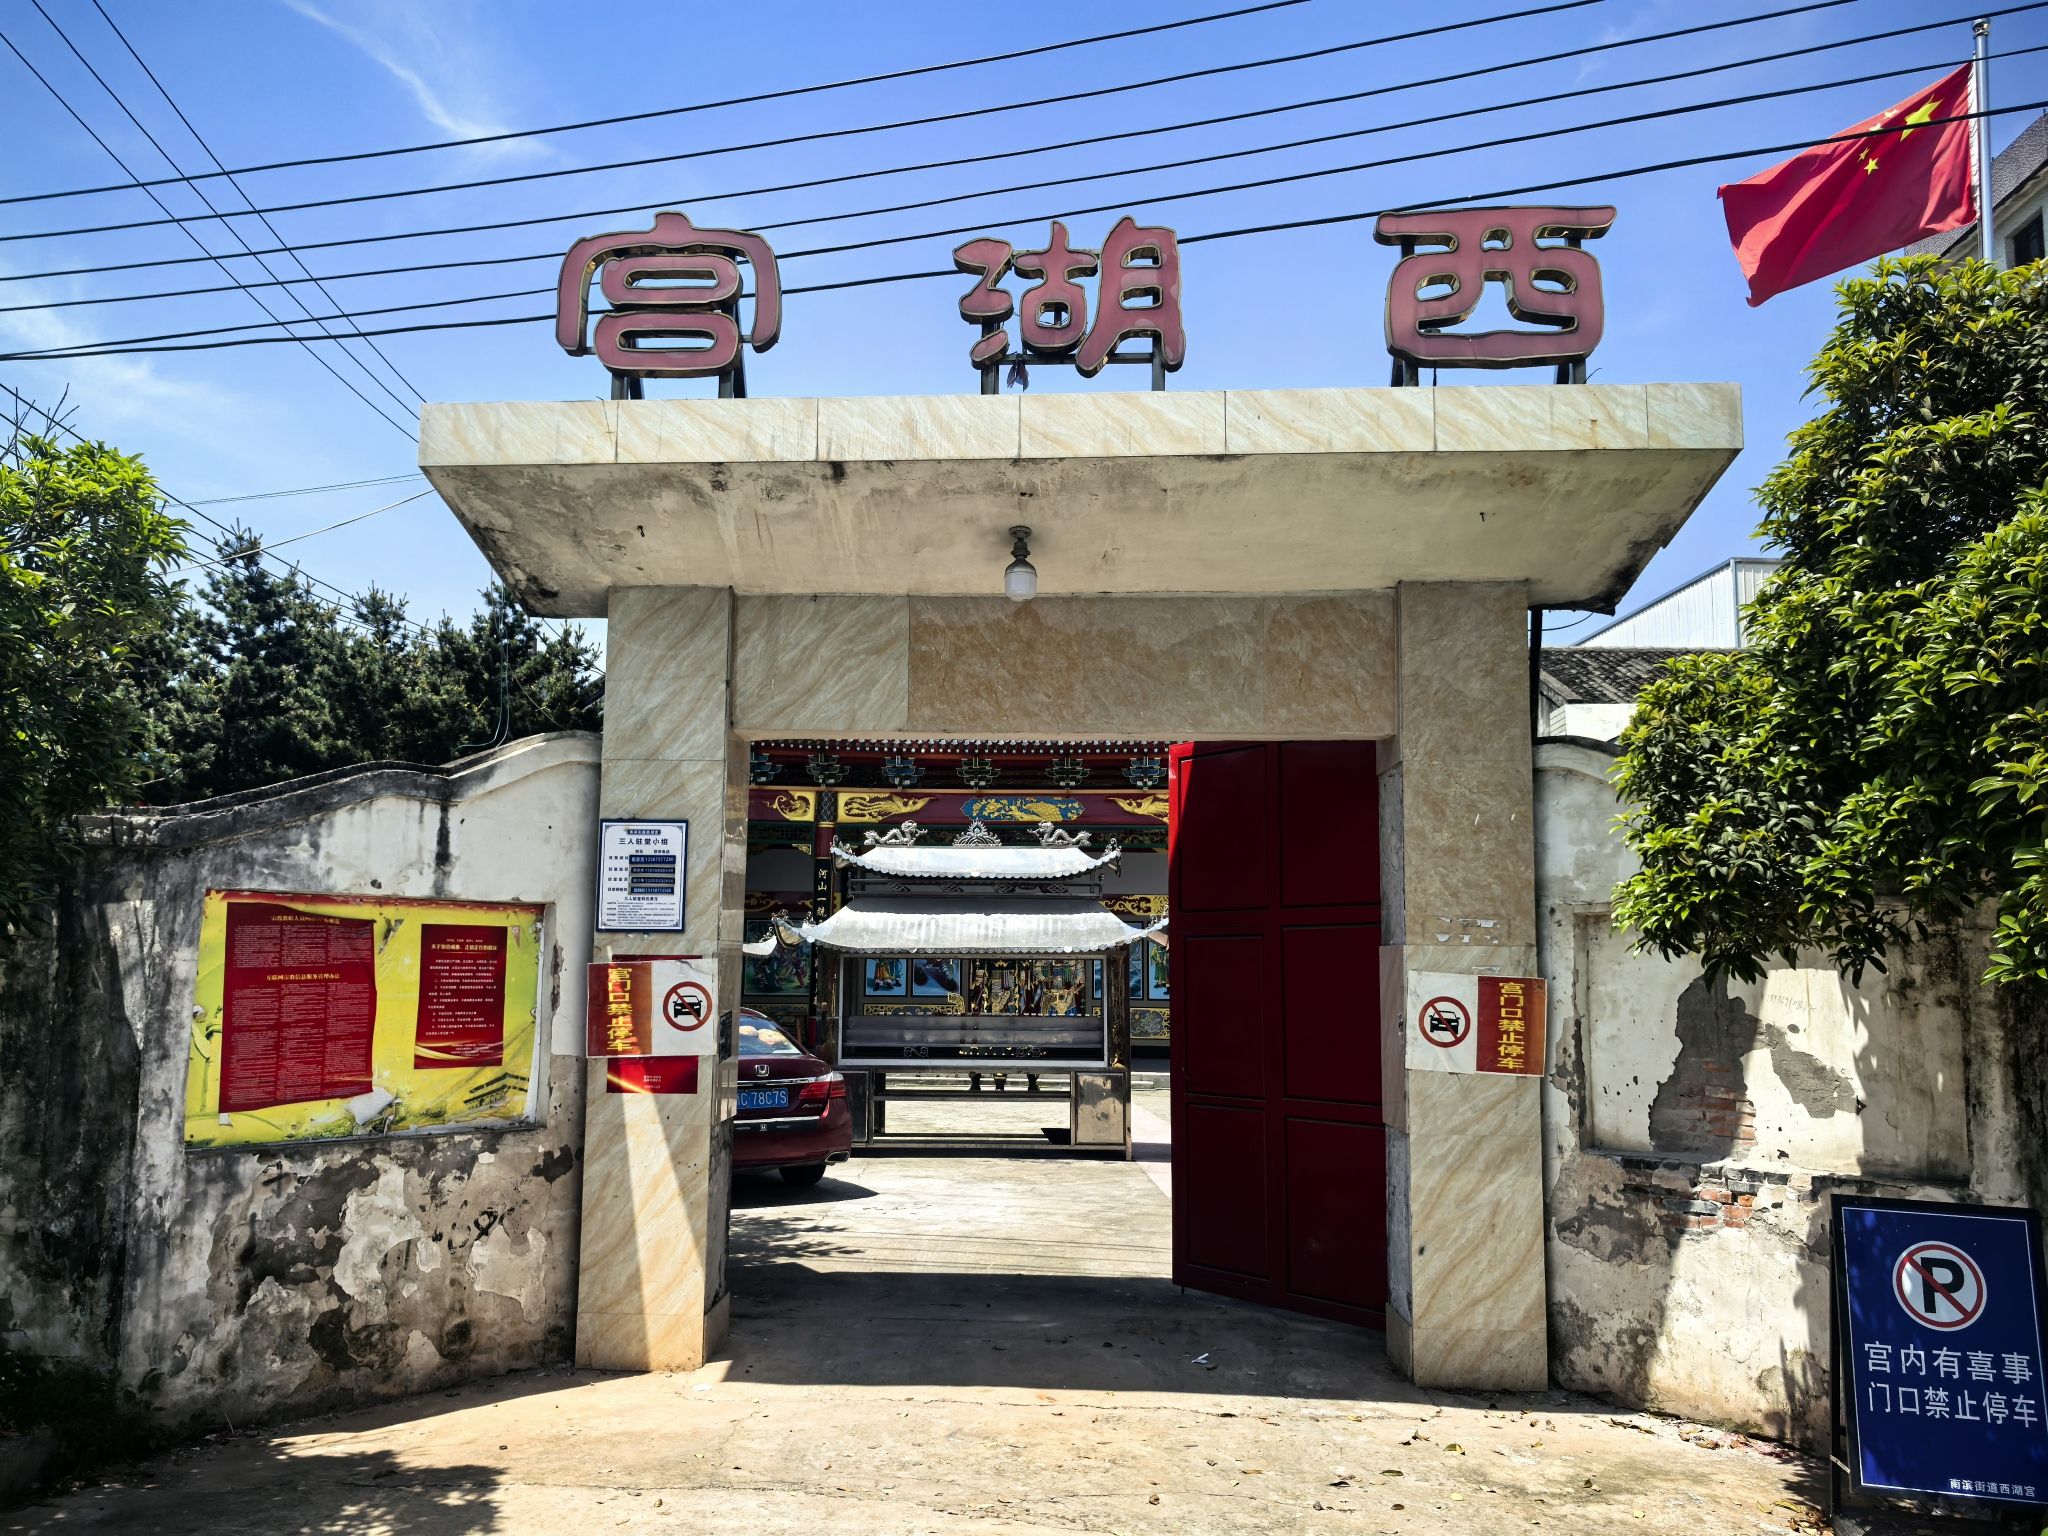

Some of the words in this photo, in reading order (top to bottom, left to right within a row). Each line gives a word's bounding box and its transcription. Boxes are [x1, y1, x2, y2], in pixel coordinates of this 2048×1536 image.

[607, 967, 633, 1052] 宫门口禁止停车
[1497, 982, 1525, 1070] 宫门口禁止停车
[1864, 1340, 2033, 1385] 宫内有喜事
[1867, 1381, 2039, 1428] 门口禁止停车
[1949, 1478, 2036, 1498] 南滨街道西湖宫
